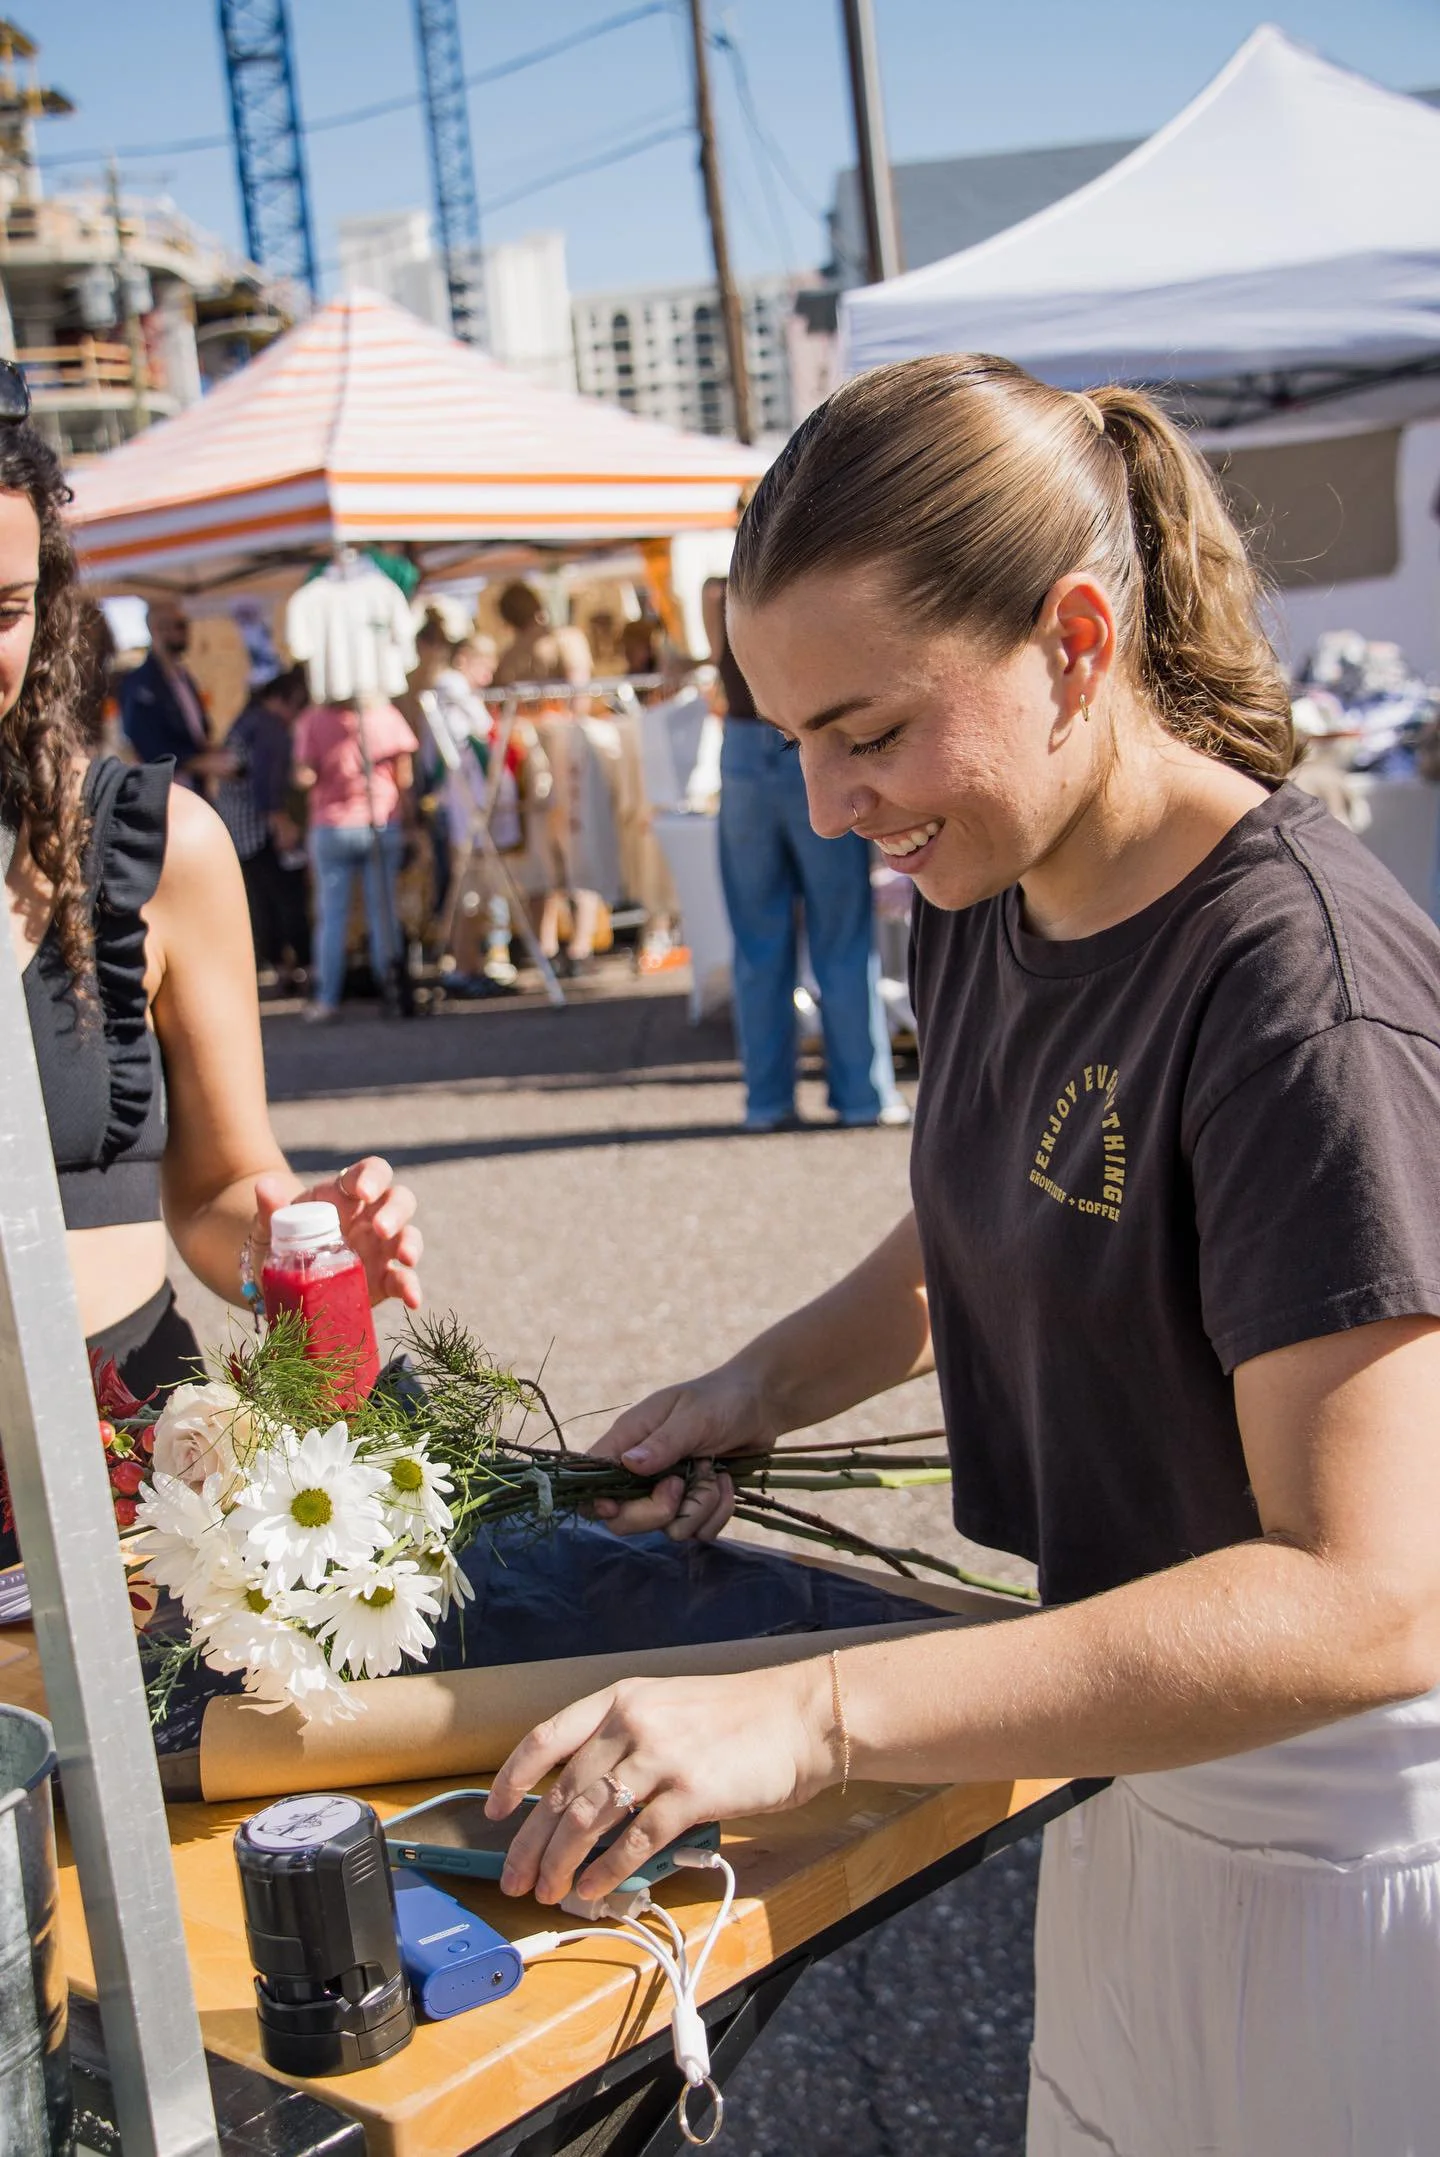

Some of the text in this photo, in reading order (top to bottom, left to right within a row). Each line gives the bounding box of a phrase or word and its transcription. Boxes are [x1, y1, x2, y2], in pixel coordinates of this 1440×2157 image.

[1035, 1064, 1127, 1204] ENJOY EVTHING
[1077, 1199, 1121, 1222] COFFEE
